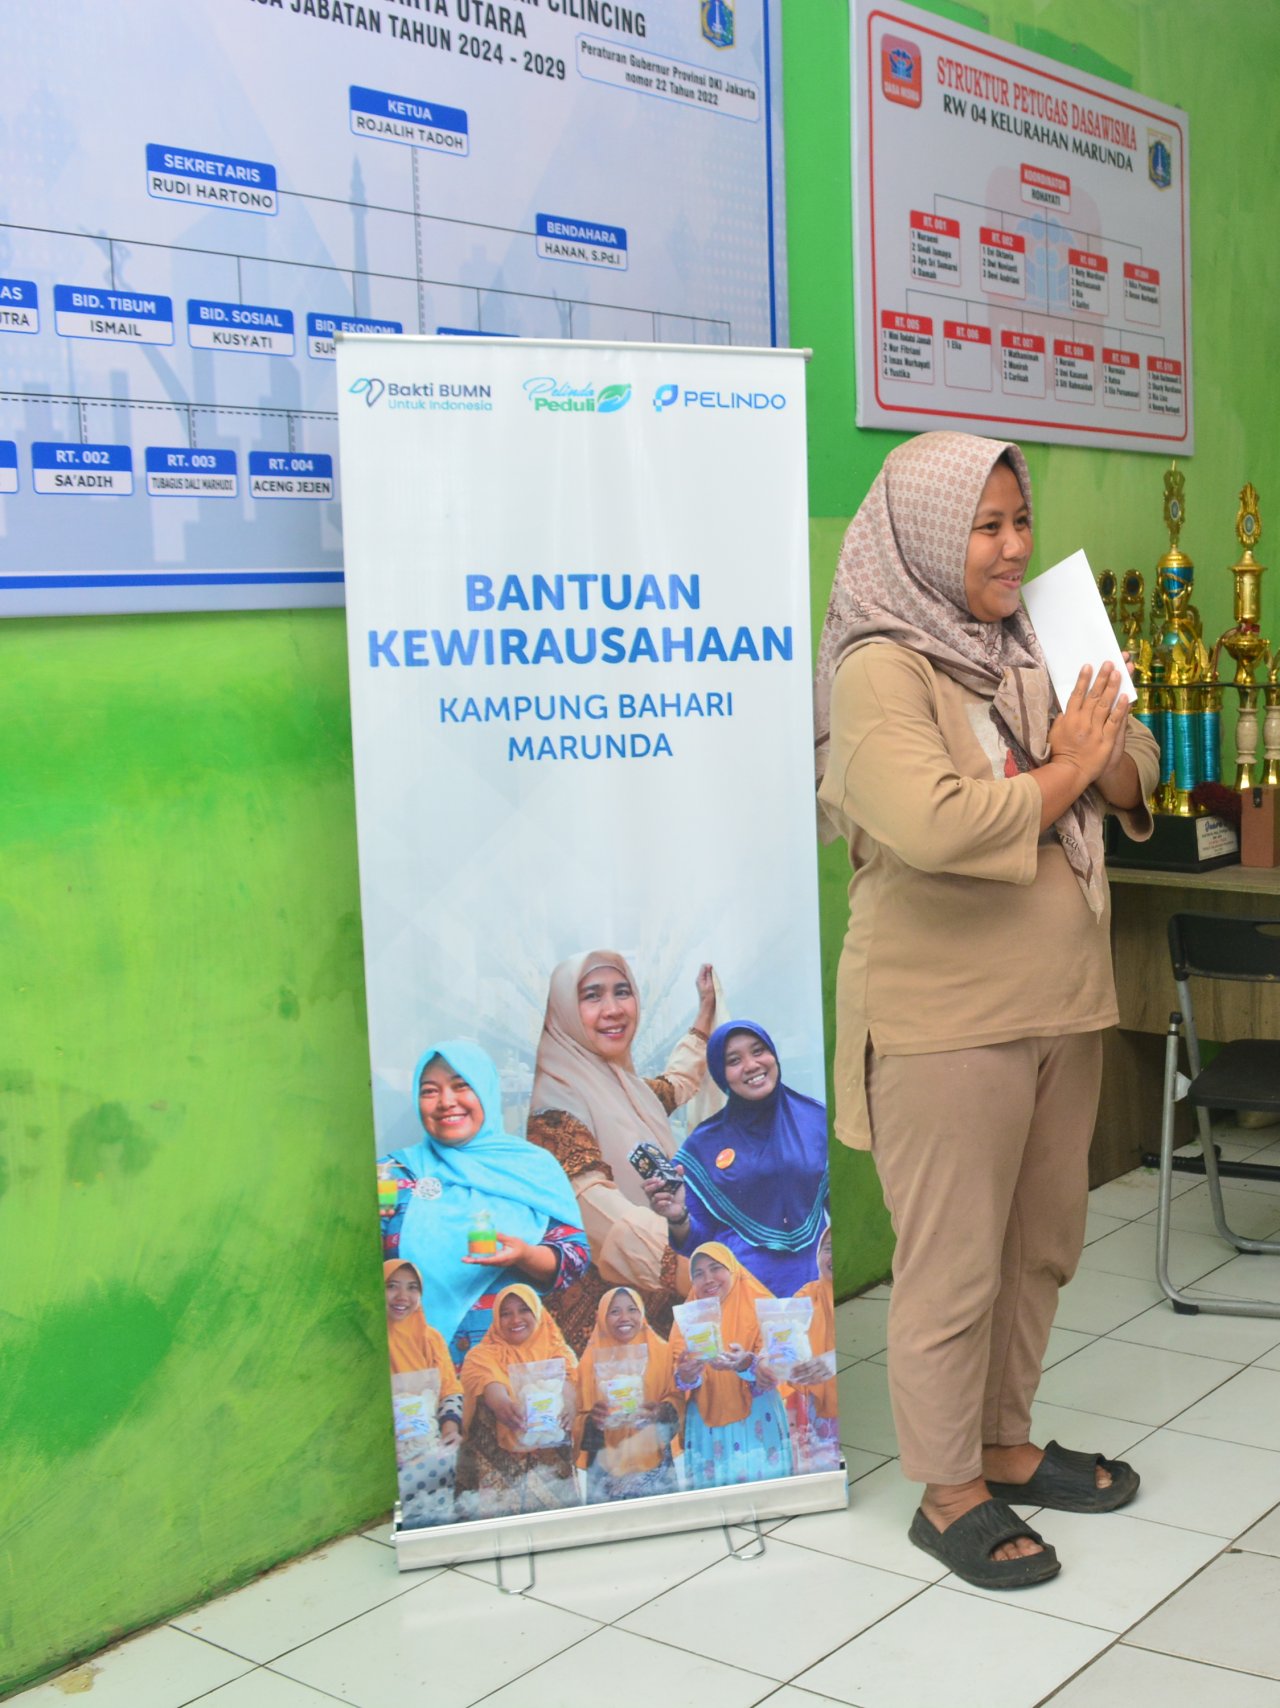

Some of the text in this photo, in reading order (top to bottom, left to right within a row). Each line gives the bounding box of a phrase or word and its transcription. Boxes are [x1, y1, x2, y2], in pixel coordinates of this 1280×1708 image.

[457, 0, 527, 38] UTARA
[289, 0, 381, 33] JABATAN
[388, 14, 451, 51] TAHUN
[458, 33, 503, 65] 2024
[523, 51, 566, 80] 2029
[581, 40, 756, 100] Peraturan Gubernur Provinsi DKI Jakarta
[625, 72, 718, 105] nomor 22 Tahun 2022
[387, 99, 433, 121] KETUA
[937, 56, 1137, 151] STRUKTUR PETUGAS DASAWISMA
[356, 116, 463, 148] ROJALIH TADOH
[944, 94, 1134, 173] RW 04 KELURAHAN MARUNDA
[163, 153, 261, 183] SEKRETARIS
[152, 177, 273, 208] RUDI HARTONO
[546, 221, 618, 245] BENDAHARA
[544, 242, 590, 261] HANAN,
[72, 293, 157, 314] BID. TIBUM
[90, 319, 142, 337] ISMAIL
[200, 306, 283, 328] BID. SOSIAL
[212, 331, 273, 349] KUSYATI
[388, 382, 491, 398] Bakti BUMN
[684, 390, 786, 410] PELINDO
[388, 399, 493, 411] Untuk Indonesia
[534, 396, 595, 412] Peduli
[56, 449, 110, 465] RT. 002
[167, 454, 216, 469] RT. 003
[268, 458, 314, 472] RT. 004
[55, 474, 113, 488] SA'ADIH
[253, 480, 330, 493] ACENG JEJEN
[465, 574, 701, 611] BANTUAN
[368, 626, 793, 668] KEWIRAUSAHAAN
[439, 692, 733, 723] KAMPUNG BAHARI
[508, 733, 673, 761] MARUNDA
